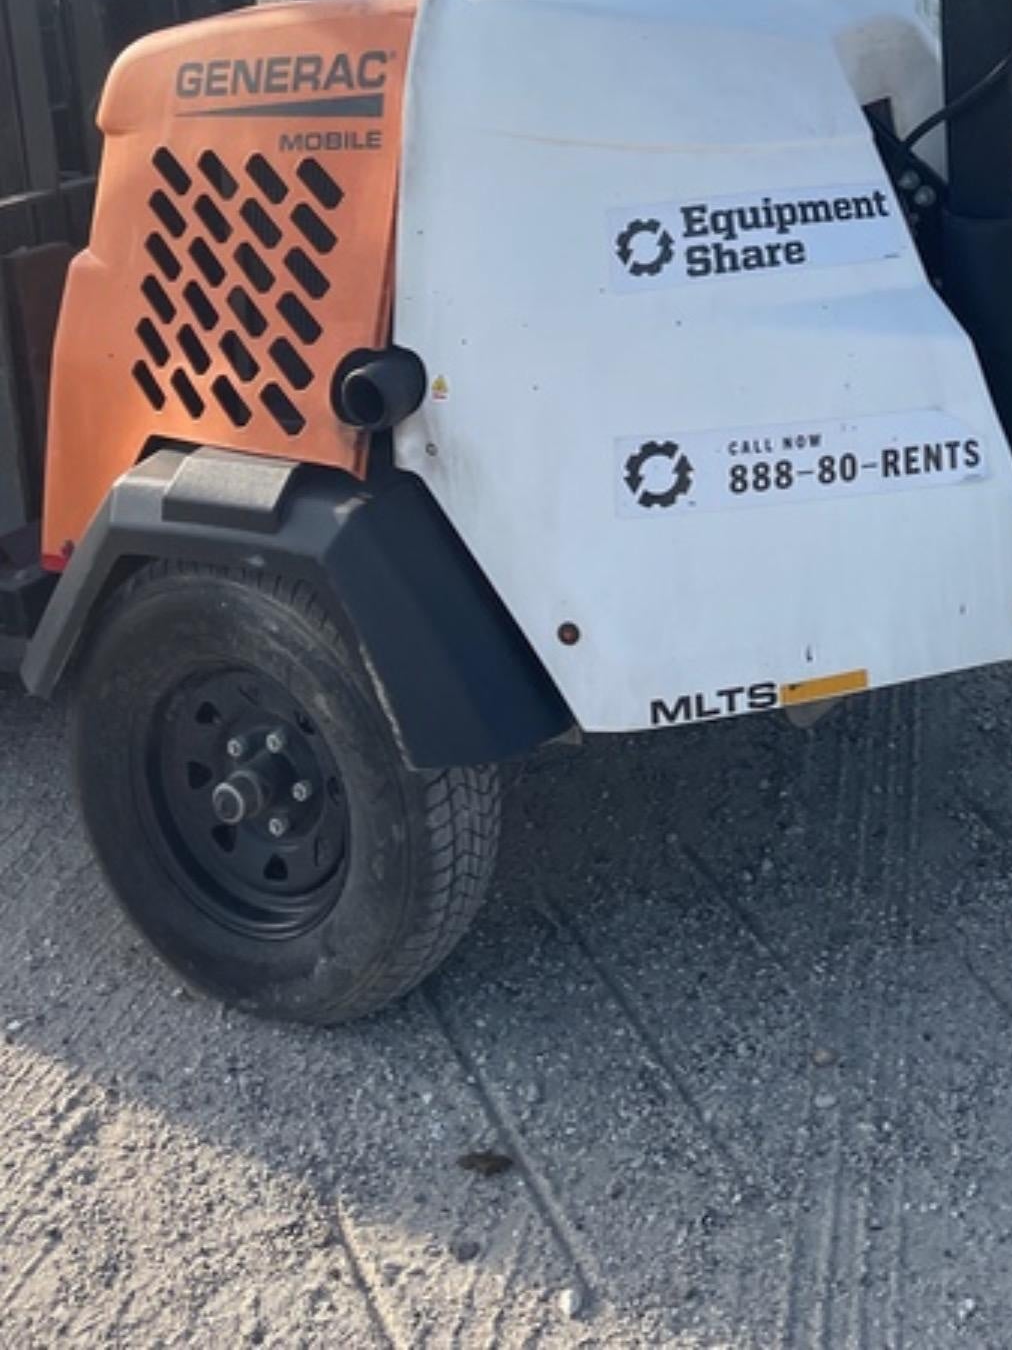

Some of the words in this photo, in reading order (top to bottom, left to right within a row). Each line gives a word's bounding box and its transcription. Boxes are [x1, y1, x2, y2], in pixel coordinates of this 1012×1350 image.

[175, 50, 388, 98] GENERAC
[280, 129, 383, 153] MOBILE
[680, 189, 890, 240] Equipment
[685, 239, 806, 277] Share
[727, 437, 773, 456] CALL
[782, 433, 823, 451] NOW
[728, 438, 981, 495] 888-80-RENTS
[650, 681, 778, 725] MLTS
